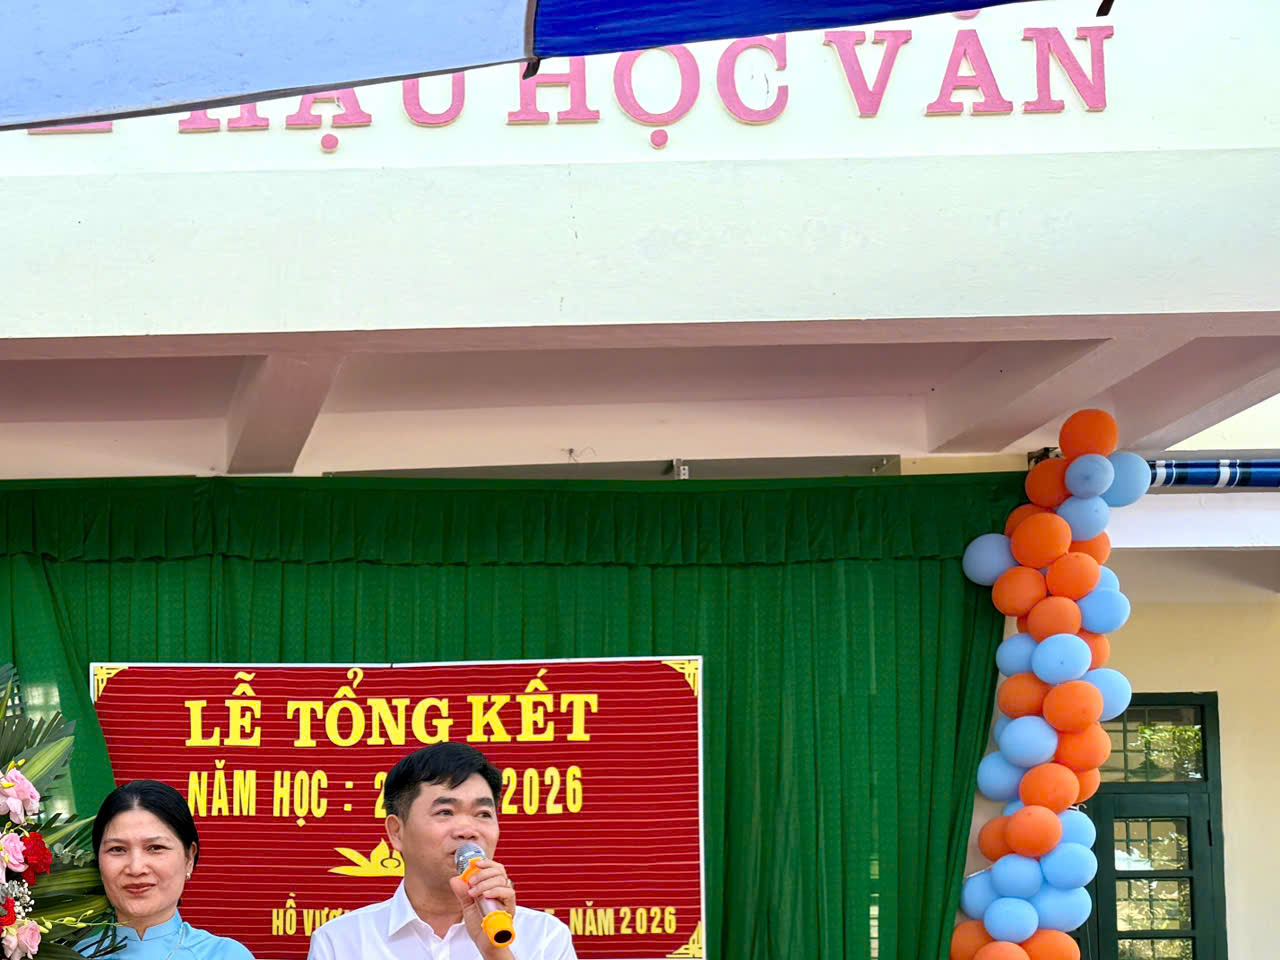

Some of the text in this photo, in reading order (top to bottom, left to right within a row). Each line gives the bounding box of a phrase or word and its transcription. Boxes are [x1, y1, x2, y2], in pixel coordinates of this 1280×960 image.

[505, 33, 789, 150] HỌC
[823, 9, 1114, 118] VĂN
[184, 667, 598, 747] LỄ TỔNG KẾT
[188, 759, 256, 817] NĂM
[273, 769, 328, 827] HỌC
[502, 765, 583, 815] 2026
[272, 891, 297, 936] HỒ
[570, 901, 676, 936] NĂM 2026
